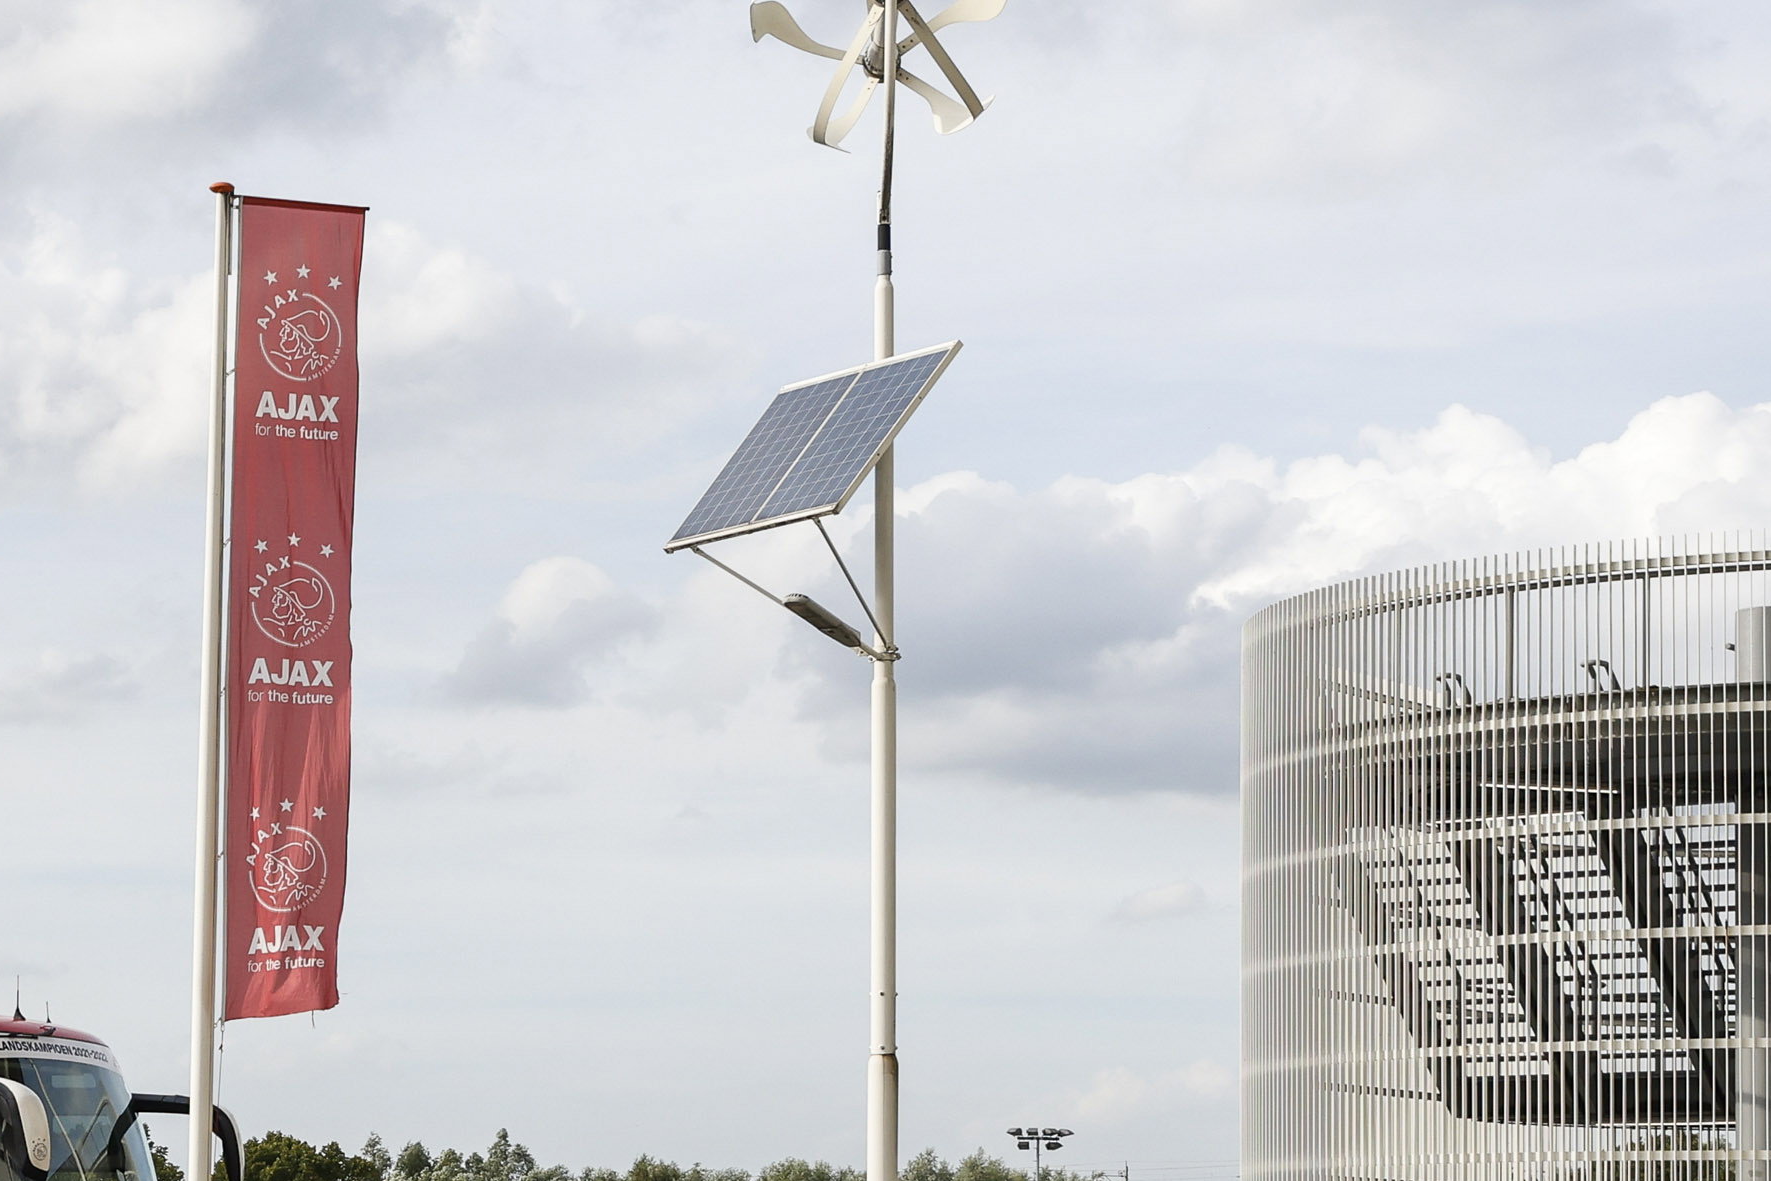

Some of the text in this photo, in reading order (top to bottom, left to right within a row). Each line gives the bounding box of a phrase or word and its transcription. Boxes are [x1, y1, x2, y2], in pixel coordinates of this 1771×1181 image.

[257, 289, 298, 330] AJAX
[307, 347, 341, 382] AMSTERDAM
[255, 390, 340, 423] AJAX
[255, 422, 339, 440] for the future
[249, 556, 291, 598] AJAX
[298, 613, 334, 648] AMSTERDAM
[248, 657, 334, 687] AJAX
[247, 689, 334, 705] for the future
[246, 822, 282, 866] AJAX
[248, 925, 325, 955] AJAX
[247, 956, 325, 973] for the future
